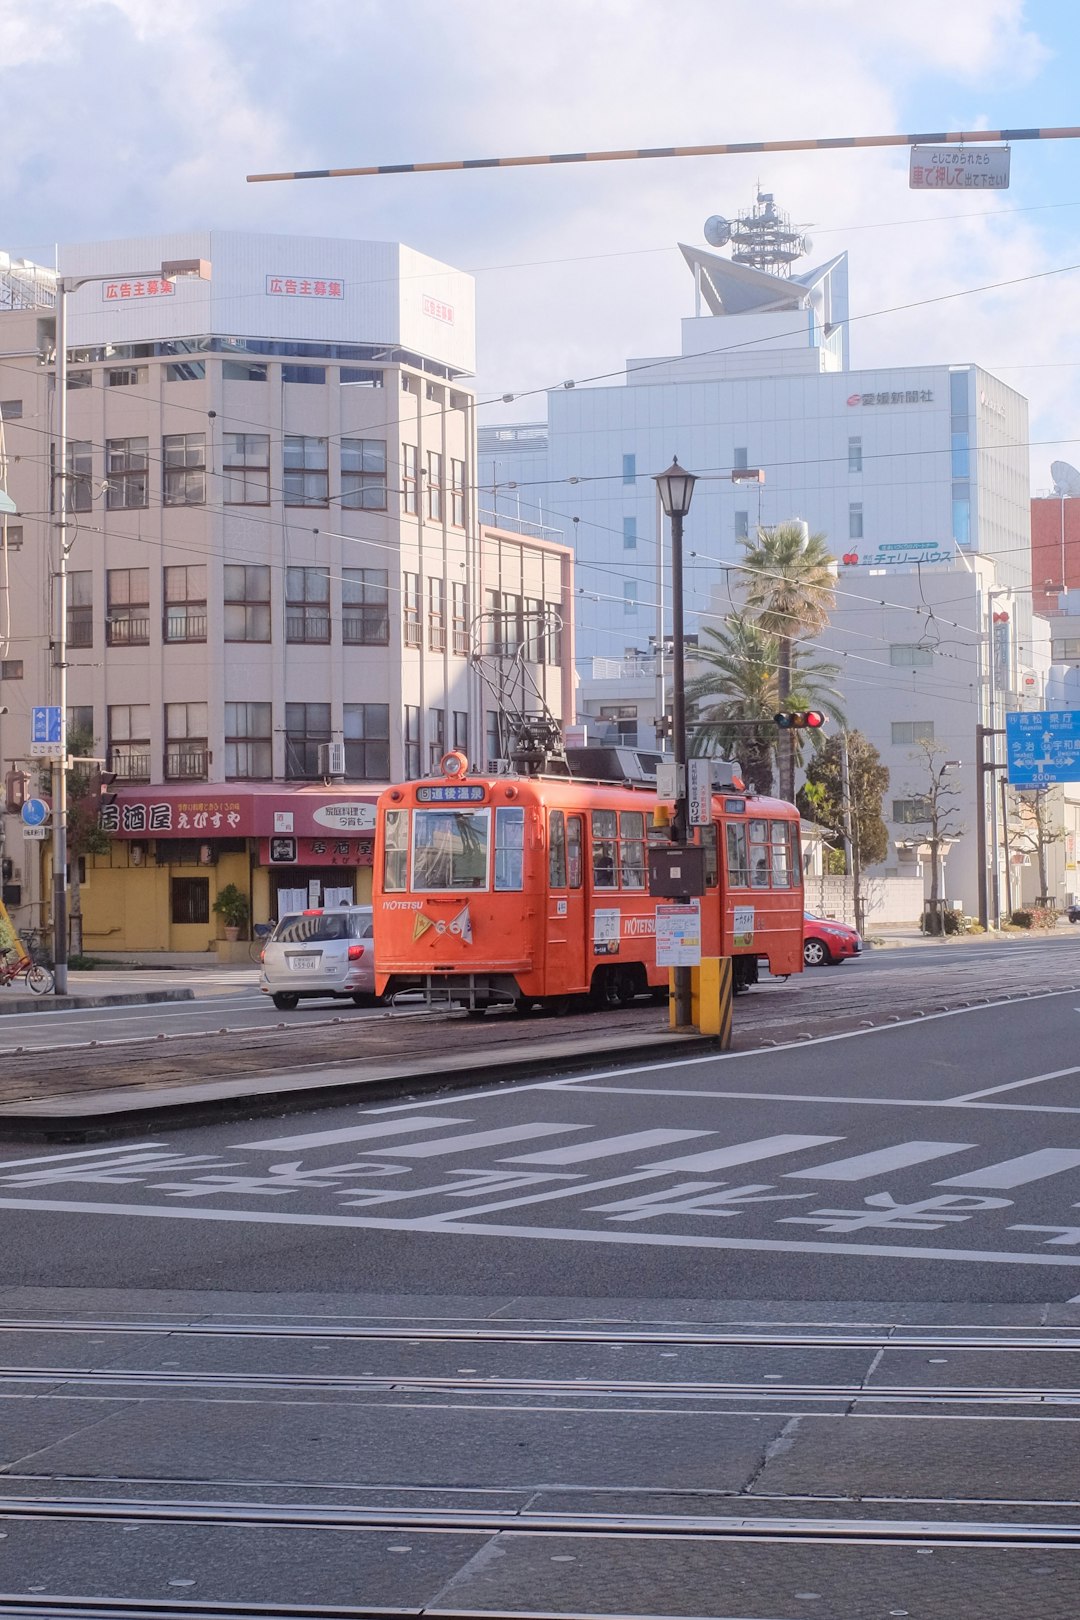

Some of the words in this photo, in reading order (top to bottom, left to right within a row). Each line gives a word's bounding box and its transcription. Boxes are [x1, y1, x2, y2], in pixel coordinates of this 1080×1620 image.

[931, 153, 990, 165] とじこめられたら
[106, 280, 172, 298] 広告主募集
[271, 279, 341, 296] 広告主募集
[862, 389, 934, 406] 愛媛新聞社
[874, 552, 951, 564] チェリーハウス
[1020, 714, 1042, 724] 高松
[1049, 713, 1072, 724] 県庁
[32, 745, 60, 754] ここまで
[1012, 741, 1035, 752] 今治
[422, 788, 429, 798] 5
[431, 787, 482, 799] 道後温泉
[98, 803, 172, 831] 居酒屋
[325, 807, 367, 816] 家庭料理で
[177, 811, 241, 829] えびすや
[340, 817, 376, 826] 今宵も一
[311, 841, 372, 855] 居酒屋
[382, 901, 423, 910] IYOTETSU
[435, 920, 461, 935] 66
